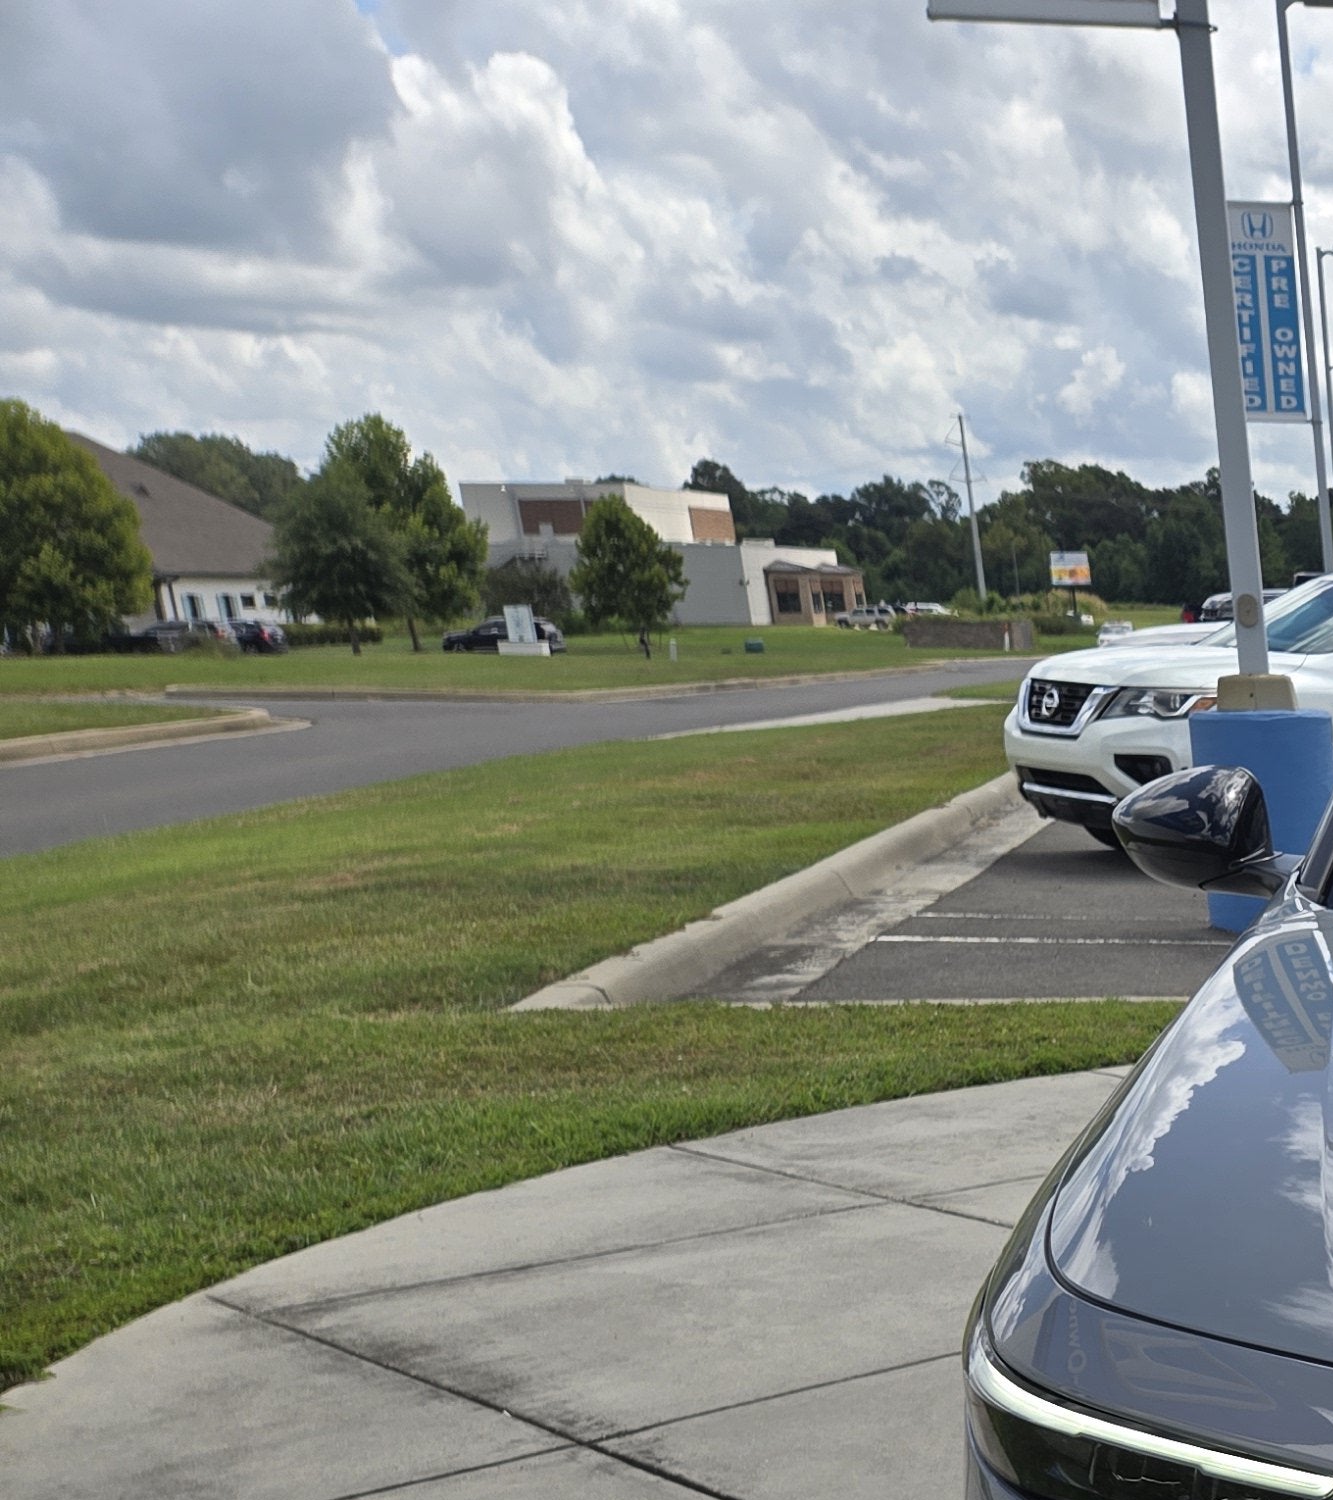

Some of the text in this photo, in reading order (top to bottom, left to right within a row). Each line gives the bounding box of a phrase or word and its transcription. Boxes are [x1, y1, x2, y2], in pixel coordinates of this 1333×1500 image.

[1231, 240, 1287, 253] HONDA
[1233, 257, 1262, 409] CERTIFIED
[1271, 258, 1298, 410] PRE OWNED
